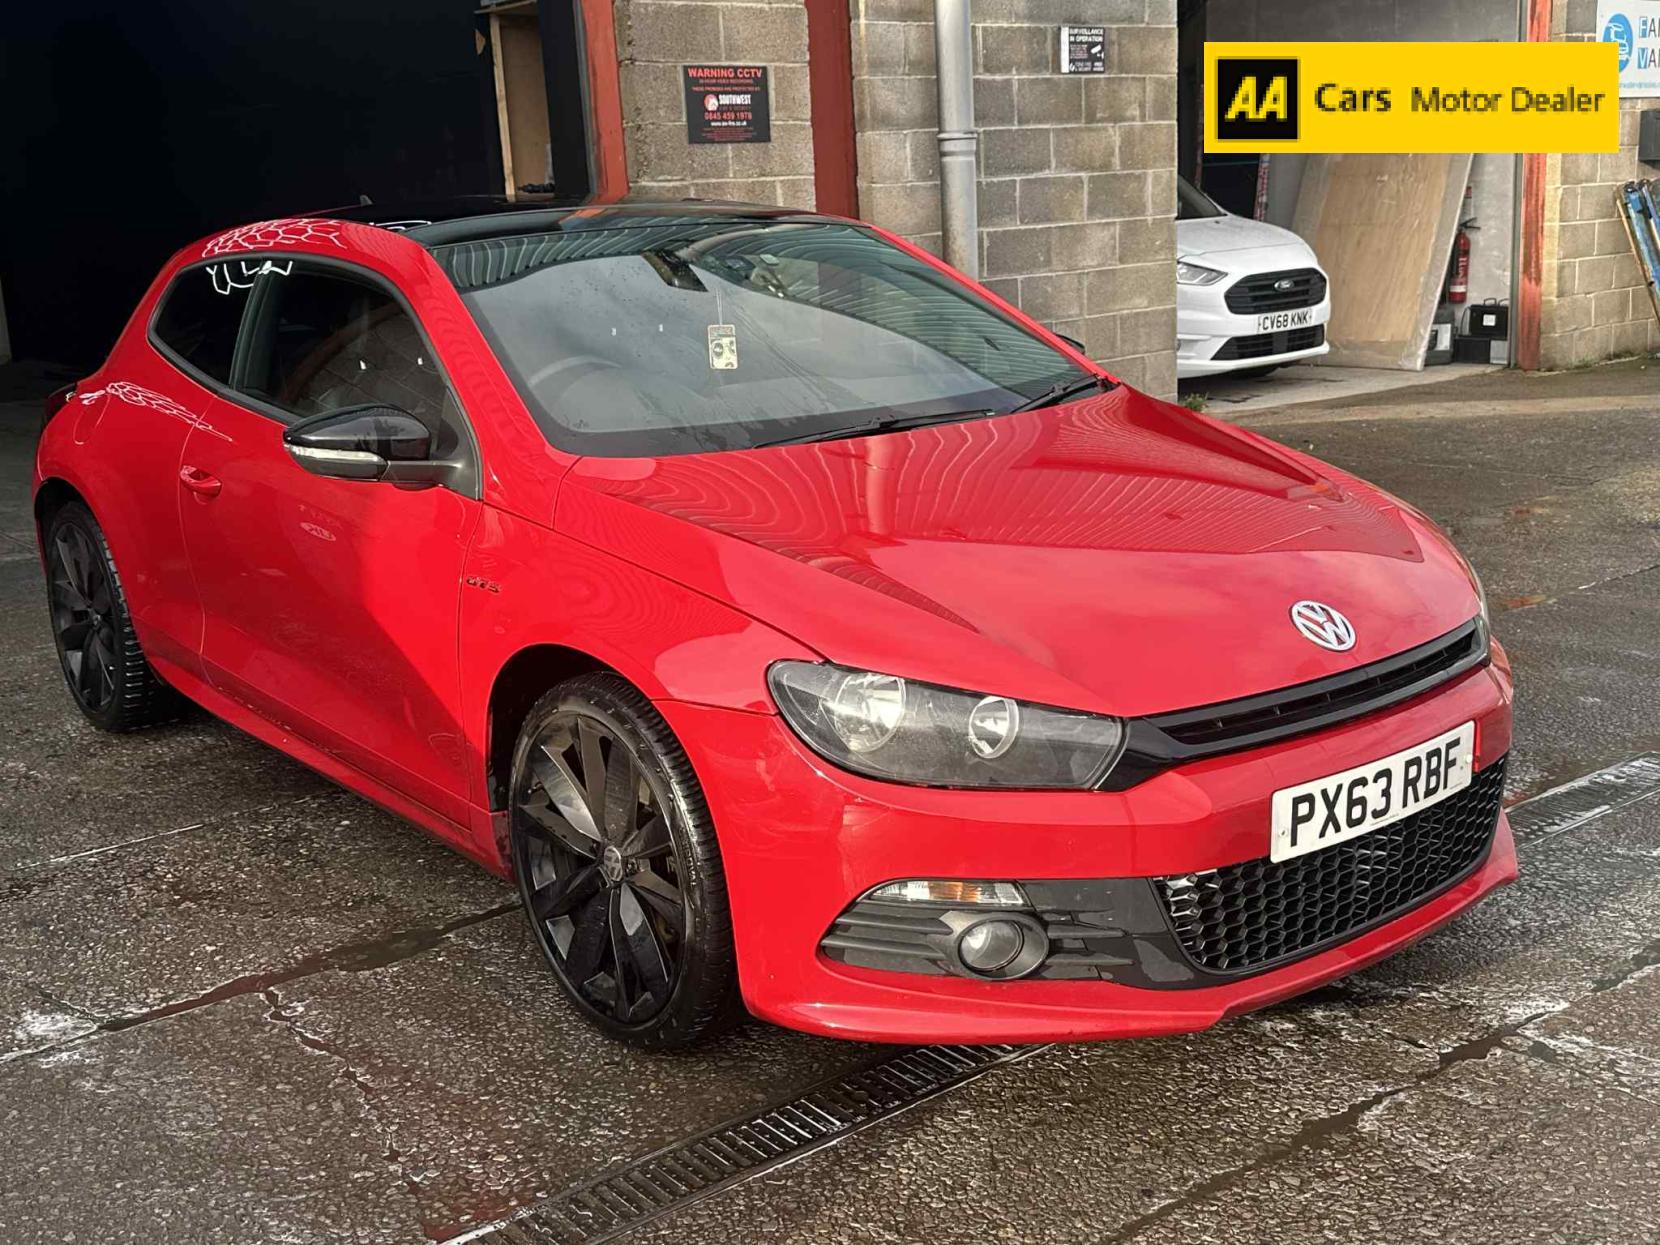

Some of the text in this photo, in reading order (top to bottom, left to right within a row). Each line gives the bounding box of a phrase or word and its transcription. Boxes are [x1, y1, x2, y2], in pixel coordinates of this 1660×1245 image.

[1638, 16, 1660, 38] FA
[1637, 47, 1660, 69] VA
[688, 67, 762, 78] WARNING CCTV
[719, 94, 751, 105] SOUTHWEST
[704, 111, 721, 121] 0845
[722, 111, 735, 121] 459
[1262, 310, 1309, 331] CV68 KNK
[1290, 736, 1461, 848] PX63 RBF
